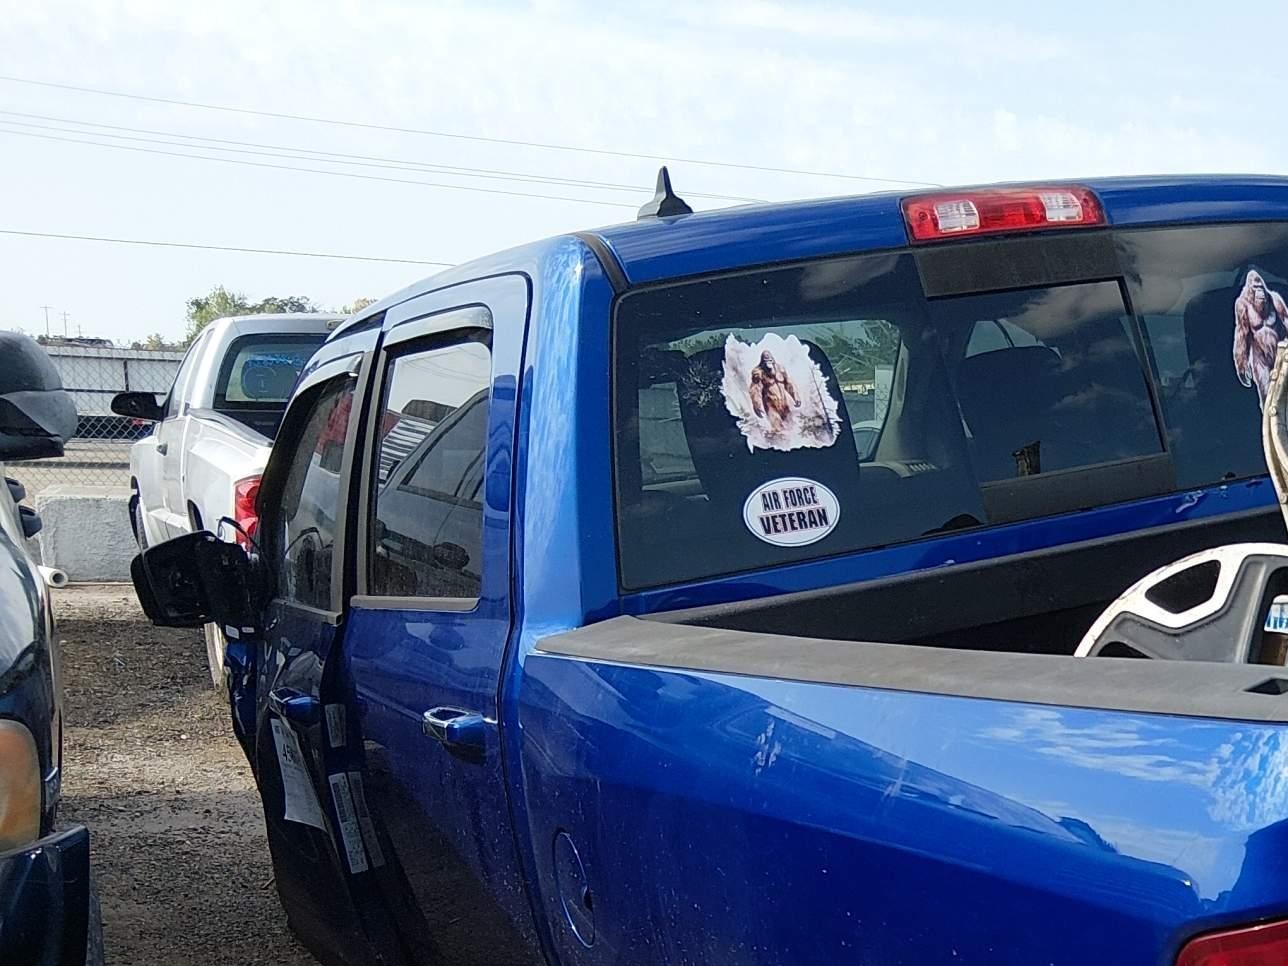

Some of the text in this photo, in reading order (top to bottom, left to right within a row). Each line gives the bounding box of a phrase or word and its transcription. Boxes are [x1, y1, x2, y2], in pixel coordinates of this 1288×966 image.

[761, 486, 818, 511] AIR FORCE
[760, 508, 829, 535] VETERAN
